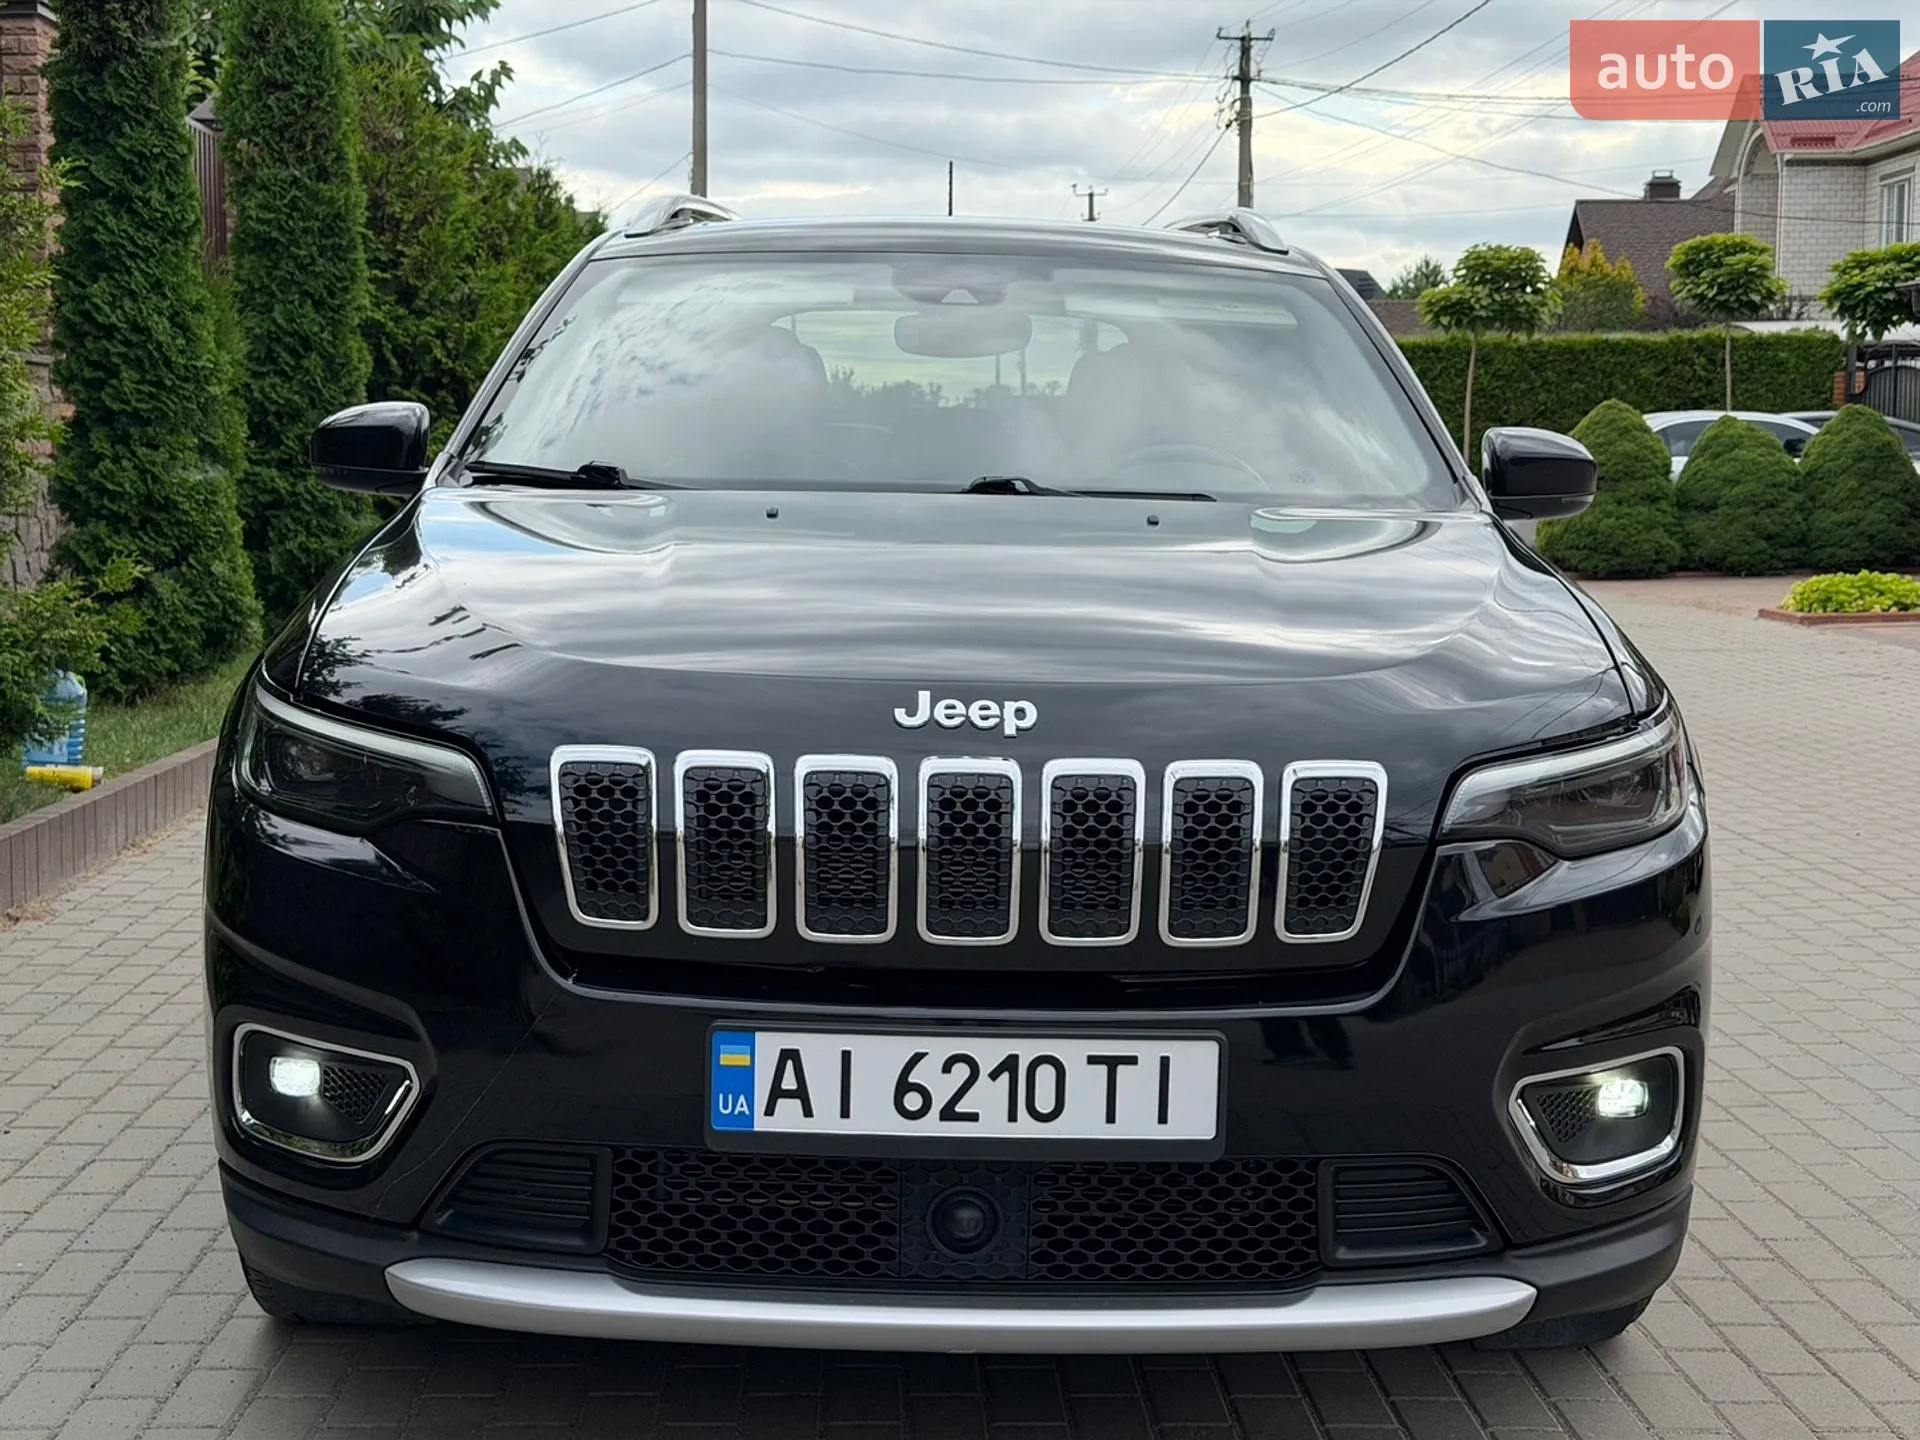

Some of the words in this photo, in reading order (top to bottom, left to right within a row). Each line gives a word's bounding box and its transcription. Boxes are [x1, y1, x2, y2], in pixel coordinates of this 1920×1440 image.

[893, 690, 1038, 738] Jeep
[719, 1093, 750, 1115] UA
[763, 1048, 852, 1119] AI
[893, 1051, 1067, 1123] 6210
[1086, 1054, 1171, 1125] TI
